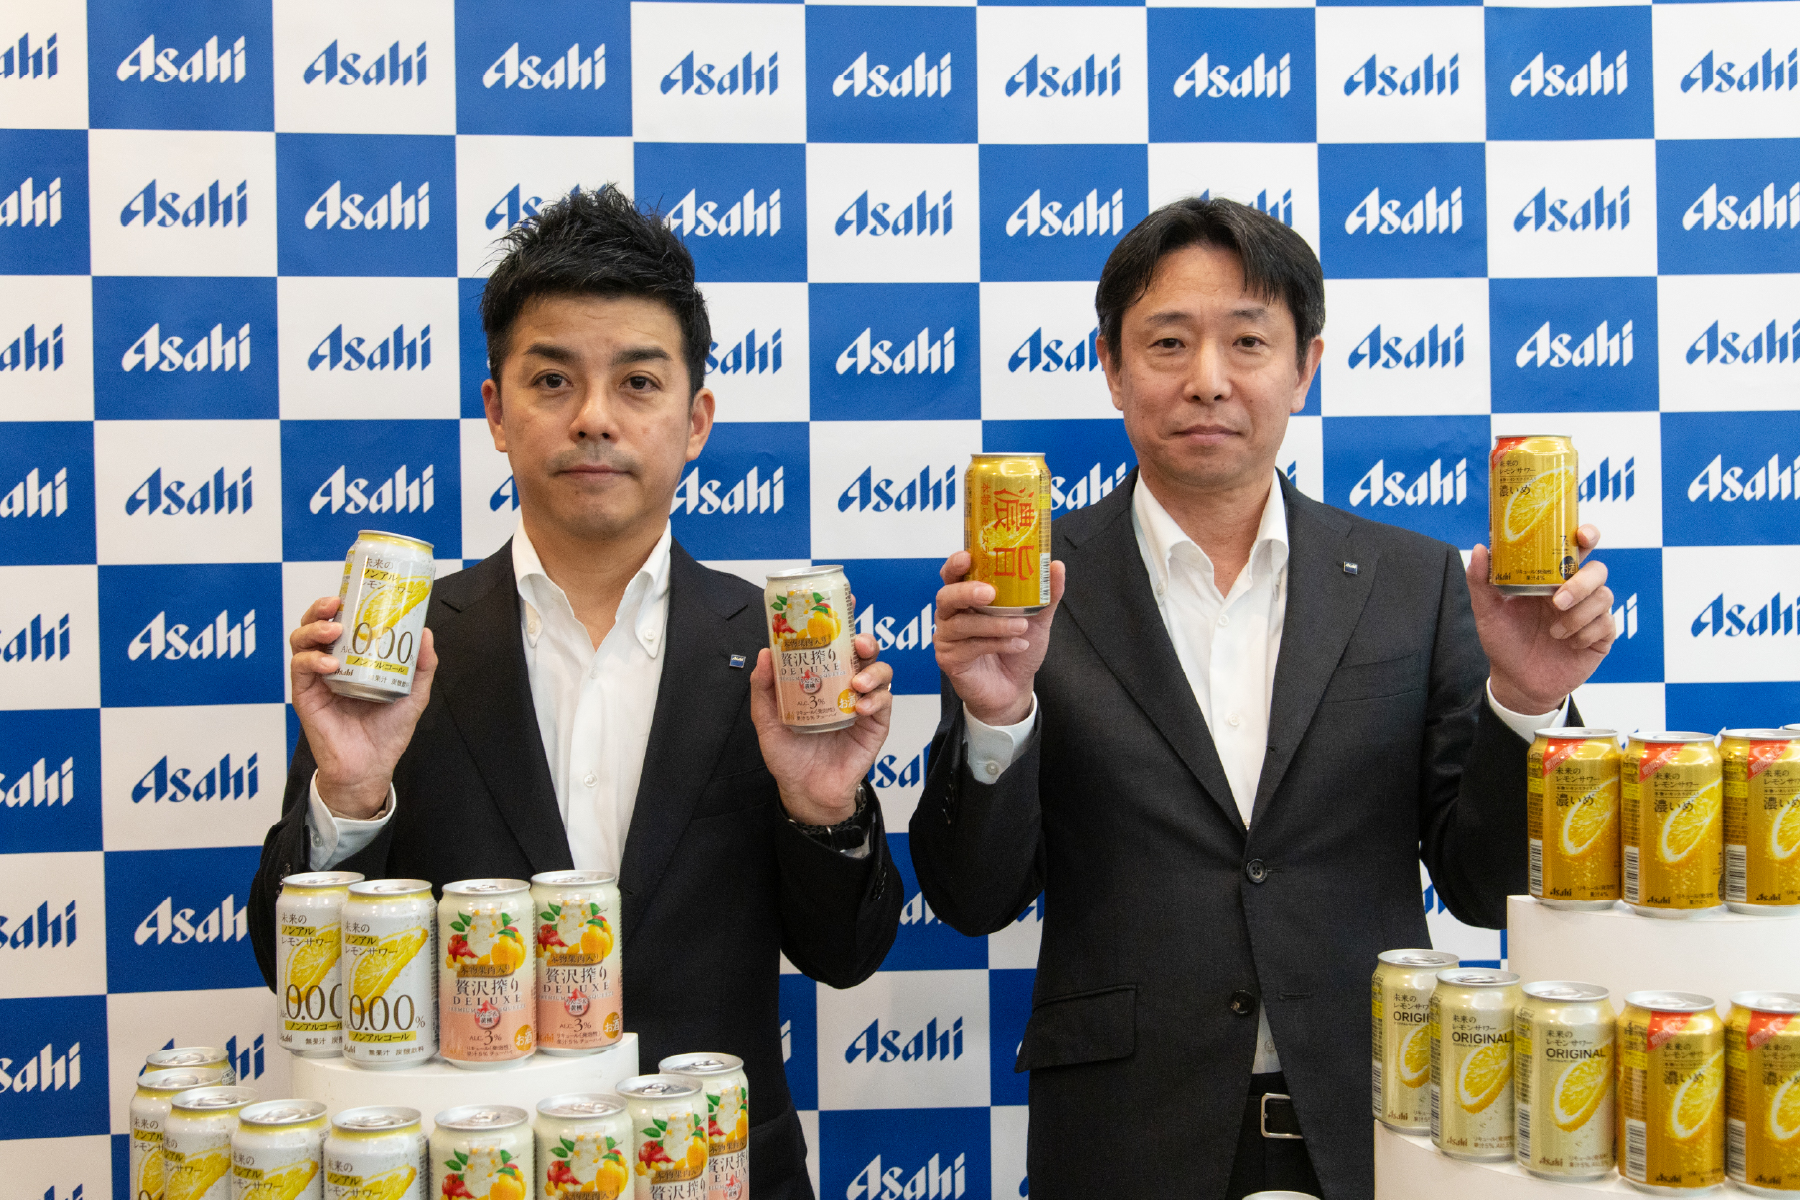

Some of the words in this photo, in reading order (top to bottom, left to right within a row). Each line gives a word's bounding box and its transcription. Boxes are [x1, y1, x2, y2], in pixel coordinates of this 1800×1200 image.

[117, 35, 246, 84] Asahi
[304, 40, 427, 86] Asahi
[483, 43, 606, 90] Asahi
[660, 51, 778, 96] Asahi
[833, 52, 952, 98] Asahi
[1005, 54, 1121, 97] Asahi
[1173, 53, 1291, 98] Asahi
[1343, 54, 1459, 97] Asahi
[1510, 50, 1628, 97] Asahi
[1680, 48, 1798, 93] Asahi
[120, 179, 247, 228] Asahi
[304, 181, 430, 230] Asahi
[660, 188, 781, 237] Asahi
[834, 190, 953, 237] Asahi
[1006, 189, 1123, 237] Asahi
[1345, 187, 1463, 235] Asahi
[1513, 185, 1630, 232] Asahi
[1682, 182, 1800, 231] Asahi
[122, 323, 251, 372] Asahi
[307, 324, 431, 371] Asahi
[704, 328, 782, 375] sahi
[836, 327, 955, 375] Asahi
[1007, 327, 1100, 373] Asa
[1347, 323, 1464, 370] Asahi
[1516, 320, 1634, 368] Asahi
[1686, 319, 1800, 365] Asahi
[126, 467, 253, 516] Asahi
[310, 465, 434, 515] Asahi
[669, 465, 784, 516] Asahi
[838, 465, 956, 513] Asahi
[1349, 458, 1467, 507] Asahi
[1499, 484, 1531, 497] 濃いめ
[1578, 456, 1635, 503] ahi
[1688, 454, 1800, 502] Asahi
[363, 581, 413, 594] モンサワー
[0, 613, 70, 663] ahi
[128, 610, 256, 661] Asahi
[782, 648, 837, 667] 贅沢搾り
[782, 662, 840, 676] DELUXE
[838, 692, 856, 708] お酒
[0, 757, 74, 808] ahi
[131, 752, 258, 804] Asahi
[1556, 766, 1580, 776] 未来の
[1556, 776, 1600, 784] レモンサワー
[1556, 793, 1595, 807] 濃いめ
[1654, 799, 1694, 813] 濃いめ
[1550, 886, 1572, 897] Asahi
[1647, 896, 1671, 904] Asahi
[1756, 892, 1781, 901] Asahi
[135, 894, 248, 946] Asah
[281, 913, 307, 924] 未来の
[282, 925, 315, 936] ノンアル
[345, 920, 370, 933] 未来の
[281, 936, 334, 947] レモンサワー
[345, 946, 398, 956] レモンサワー
[346, 935, 377, 946] ノンアル
[456, 978, 520, 996] 贅沢搾り
[543, 982, 610, 994] DELUXE
[546, 966, 608, 984] 贅沢搾り
[453, 994, 521, 1005] DELUXE
[1394, 994, 1416, 1002] 未来の
[1394, 1002, 1429, 1010] レモンサワ
[1452, 1014, 1476, 1024] 未来の
[352, 1032, 410, 1042] ノンアルコール
[484, 1030, 502, 1046] 3%
[516, 1030, 533, 1046] お酒
[574, 1018, 592, 1032] 3%
[604, 1020, 620, 1033] お酒
[845, 1016, 963, 1064] Asahi
[1452, 1031, 1510, 1044] ORIGINAL
[1546, 1048, 1606, 1060] ORIGINAL
[134, 1117, 158, 1130] 未来の
[1388, 1110, 1408, 1120] Asahi
[1446, 1136, 1468, 1148] Asahi
[1539, 1156, 1564, 1168] Asahi
[165, 1161, 203, 1174] モンサワー
[329, 1172, 360, 1186] ノンアル
[846, 1152, 965, 1200] Asahi
[1656, 1173, 1682, 1184] Asahi
